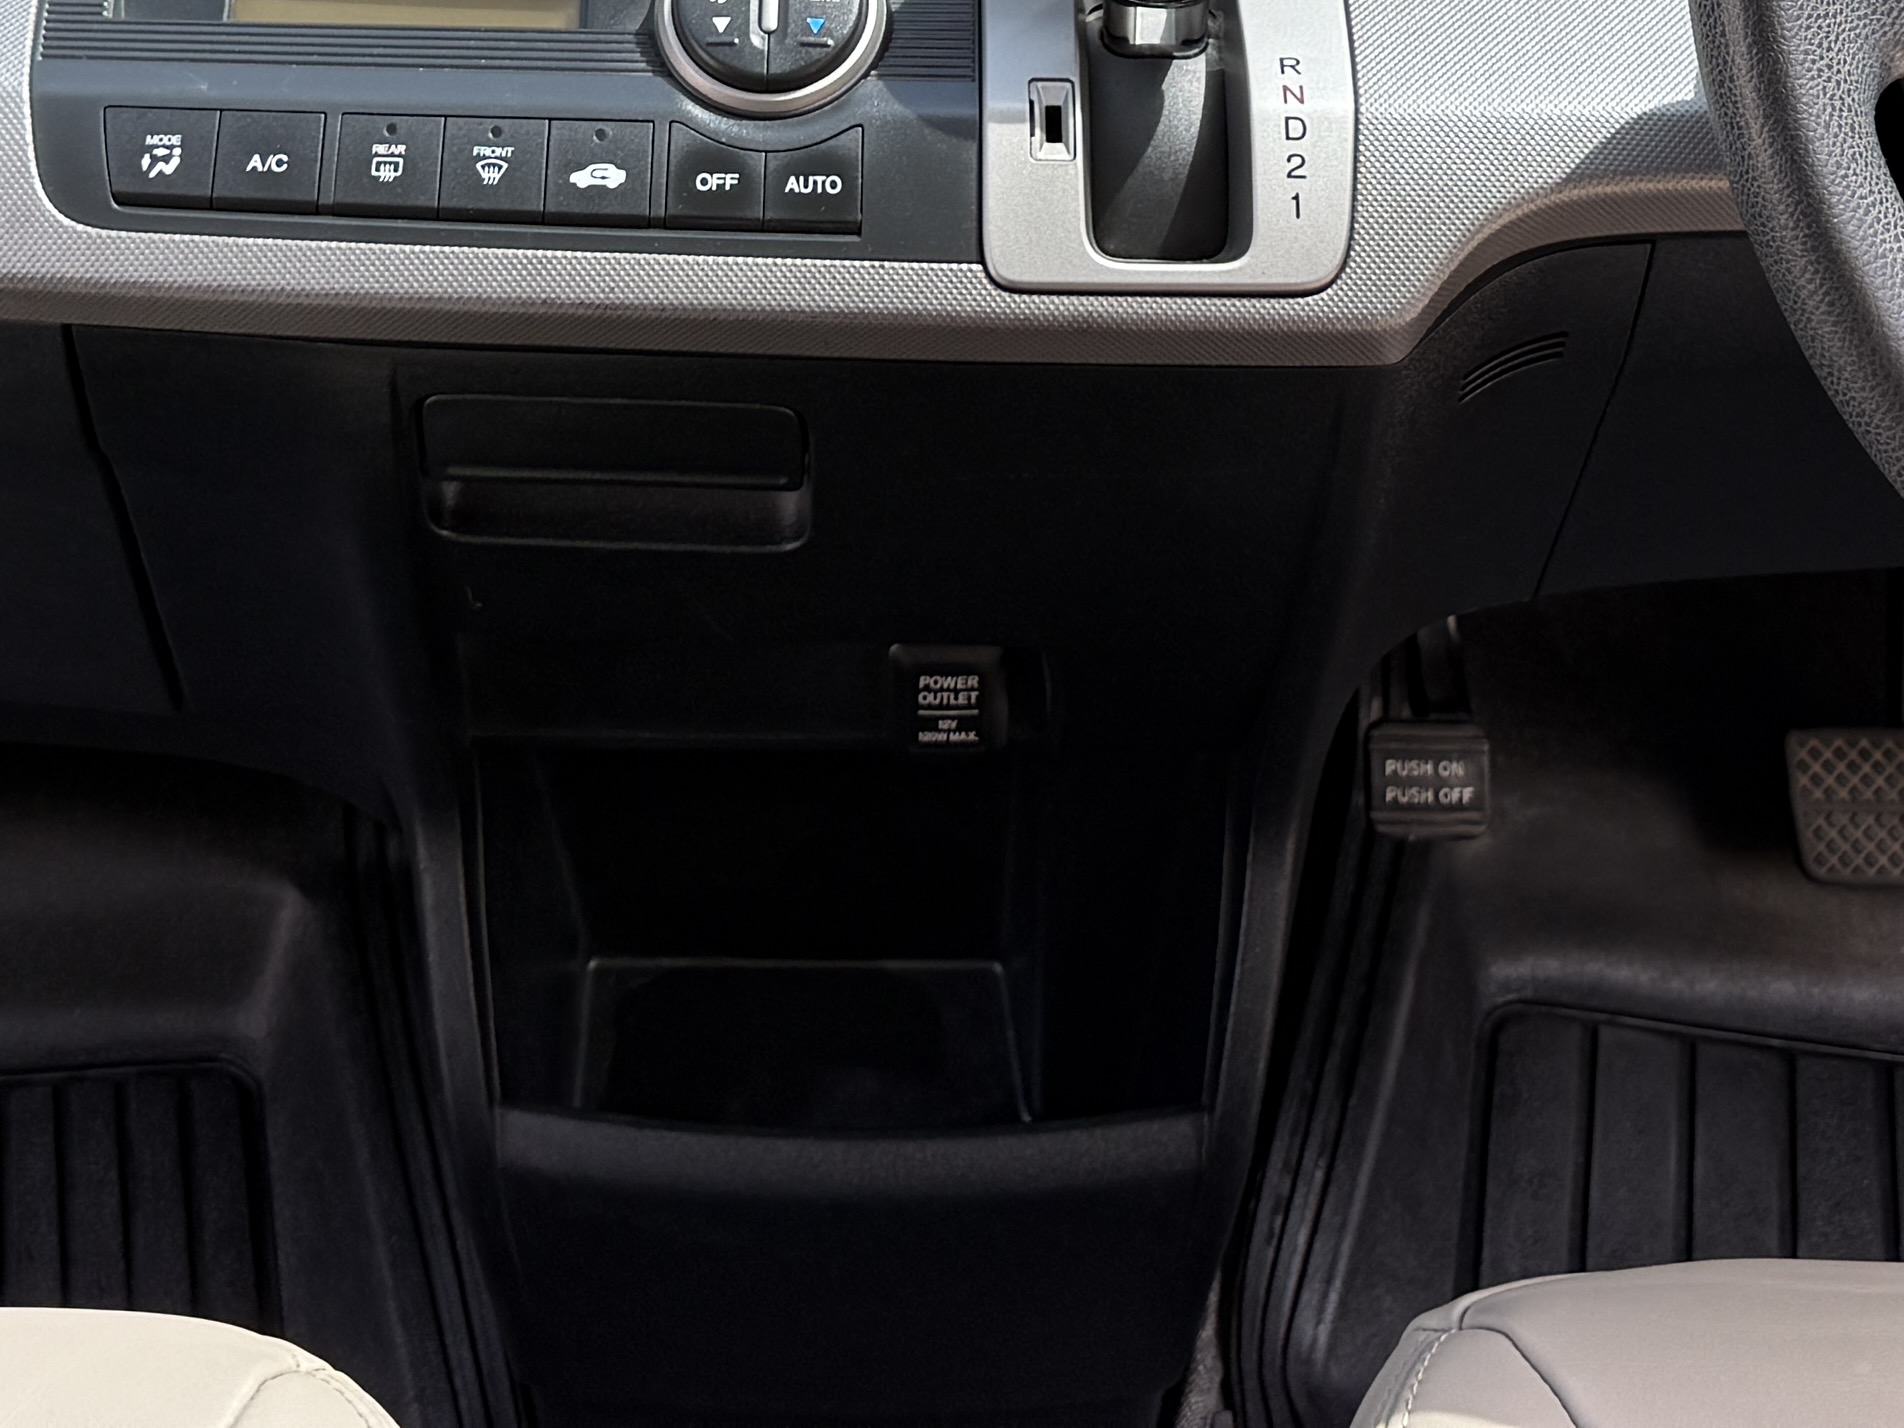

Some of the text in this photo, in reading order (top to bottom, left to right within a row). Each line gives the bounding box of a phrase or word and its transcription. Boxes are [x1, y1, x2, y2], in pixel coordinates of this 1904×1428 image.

[1279, 57, 1302, 75] R
[1281, 85, 1305, 105] N
[1284, 116, 1307, 141] D
[145, 135, 182, 146] MODE
[372, 144, 406, 156] REAR
[473, 146, 515, 158] FRONT
[245, 153, 288, 173] A/C
[1286, 153, 1307, 179] 2
[696, 173, 740, 191] OFF
[784, 175, 842, 194] AUTO
[1290, 191, 1301, 219] 1
[919, 675, 980, 690] POWER
[918, 691, 980, 706] OUTLET
[1385, 759, 1465, 777] PUSH ON
[1385, 786, 1474, 805] PUSH OFF
